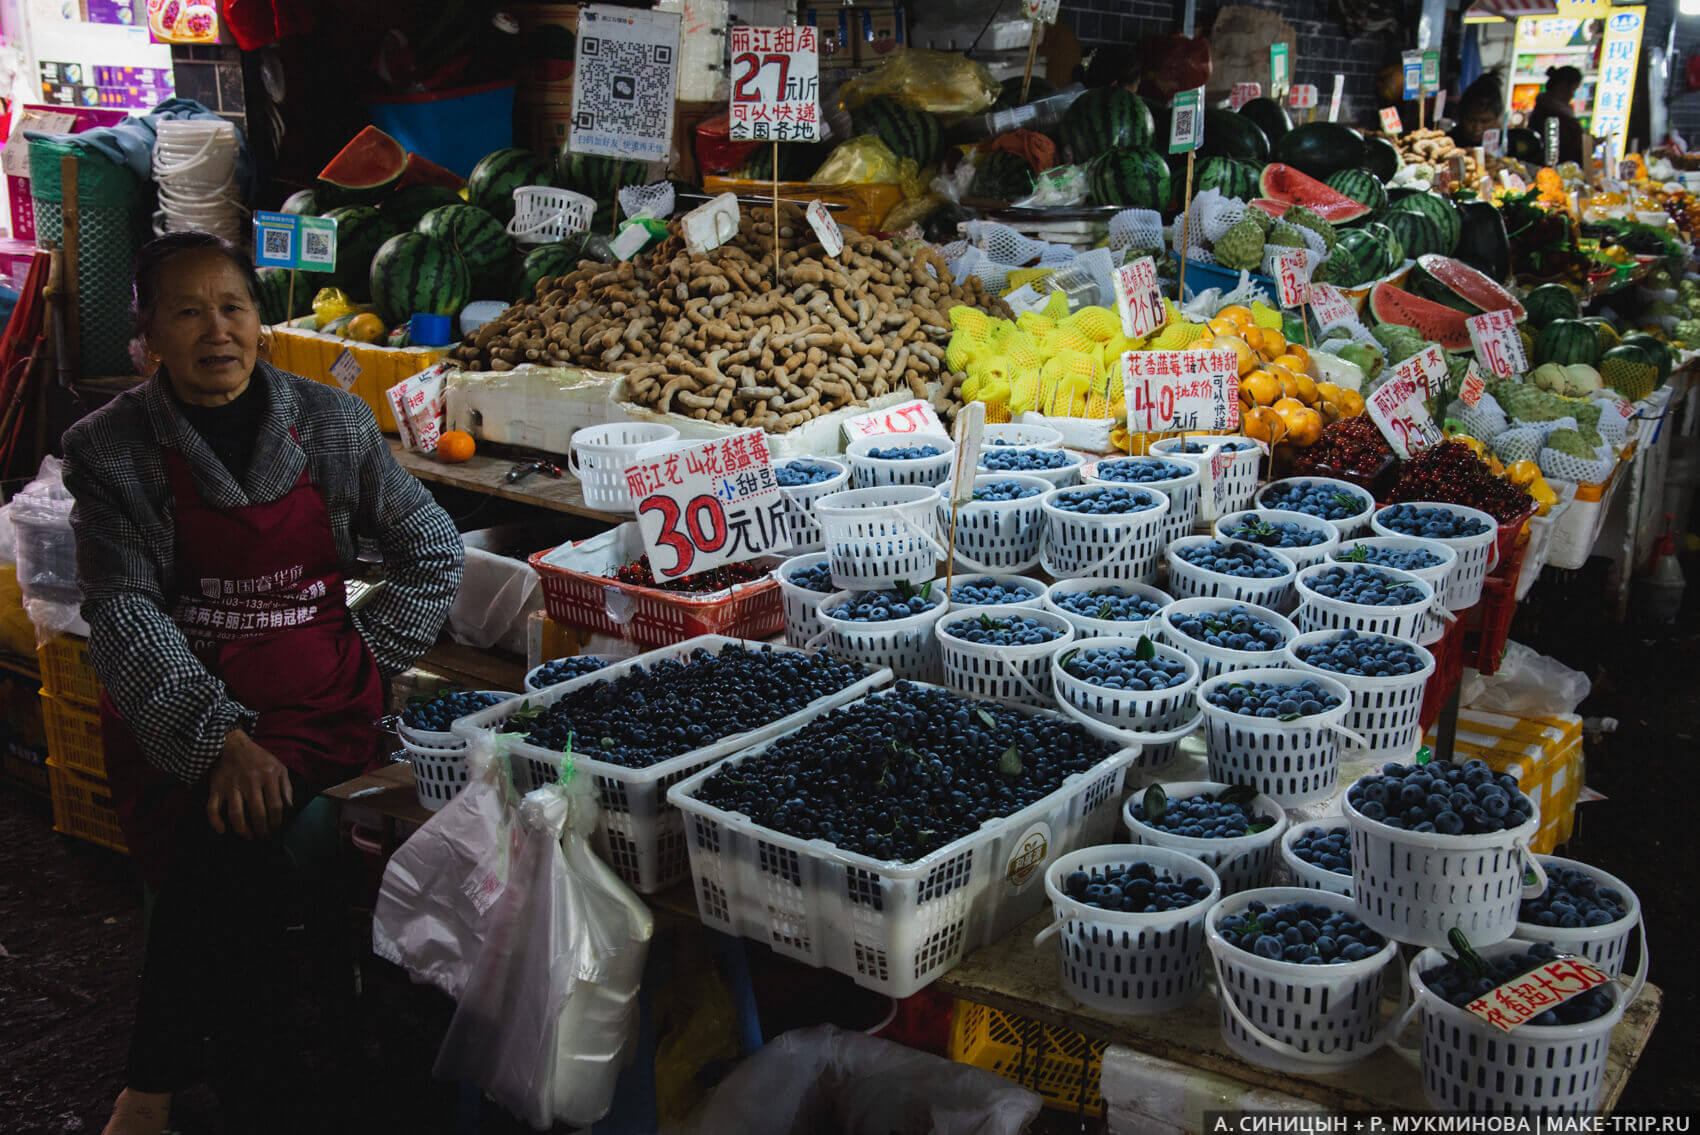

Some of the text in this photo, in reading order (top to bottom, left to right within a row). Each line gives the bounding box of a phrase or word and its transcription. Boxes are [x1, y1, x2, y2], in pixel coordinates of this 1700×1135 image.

[732, 27, 816, 53] 丽江甜角
[732, 102, 817, 122] 可以快递
[718, 468, 776, 500] 小甜豆
